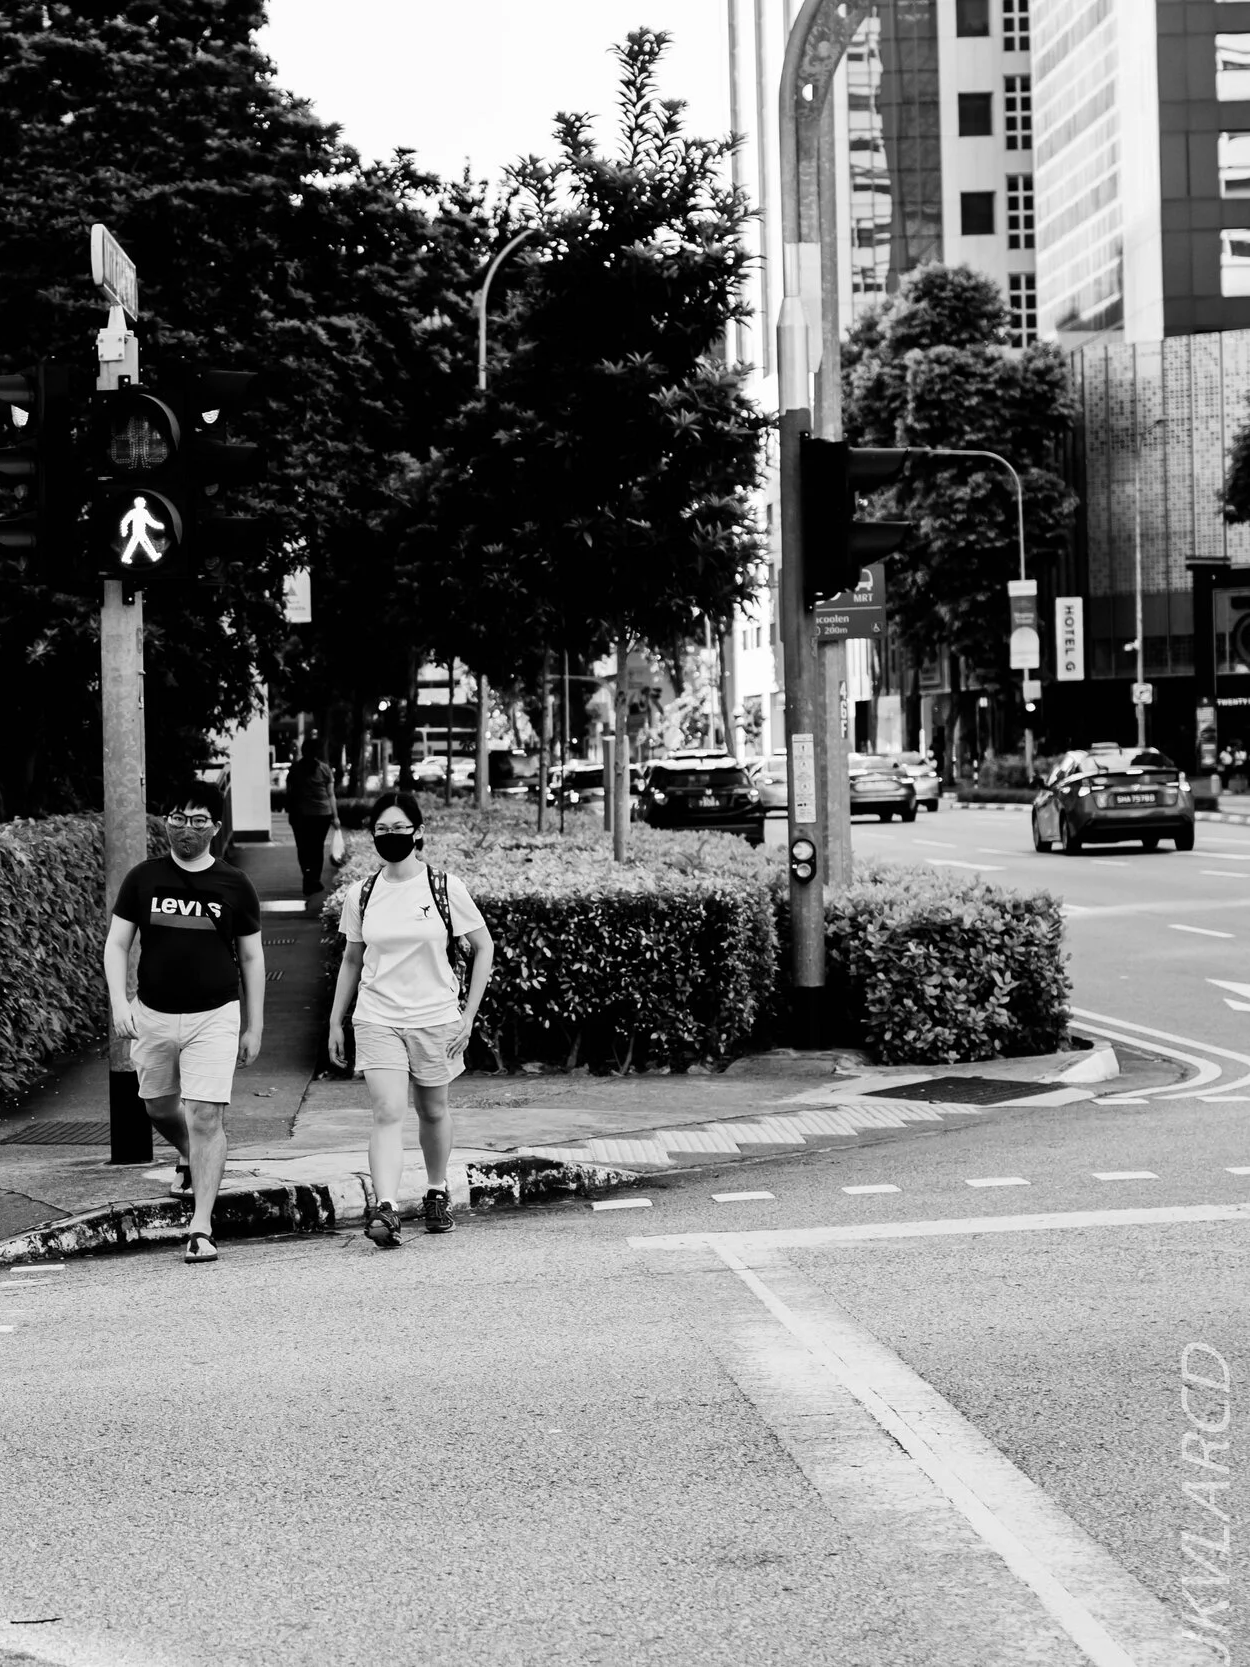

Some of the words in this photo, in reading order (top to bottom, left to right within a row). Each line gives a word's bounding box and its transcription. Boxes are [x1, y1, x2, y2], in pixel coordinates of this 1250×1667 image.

[853, 593, 873, 602] MRT
[824, 625, 848, 635] 200m
[1064, 604, 1075, 656] HOTEL
[1065, 660, 1076, 673] G
